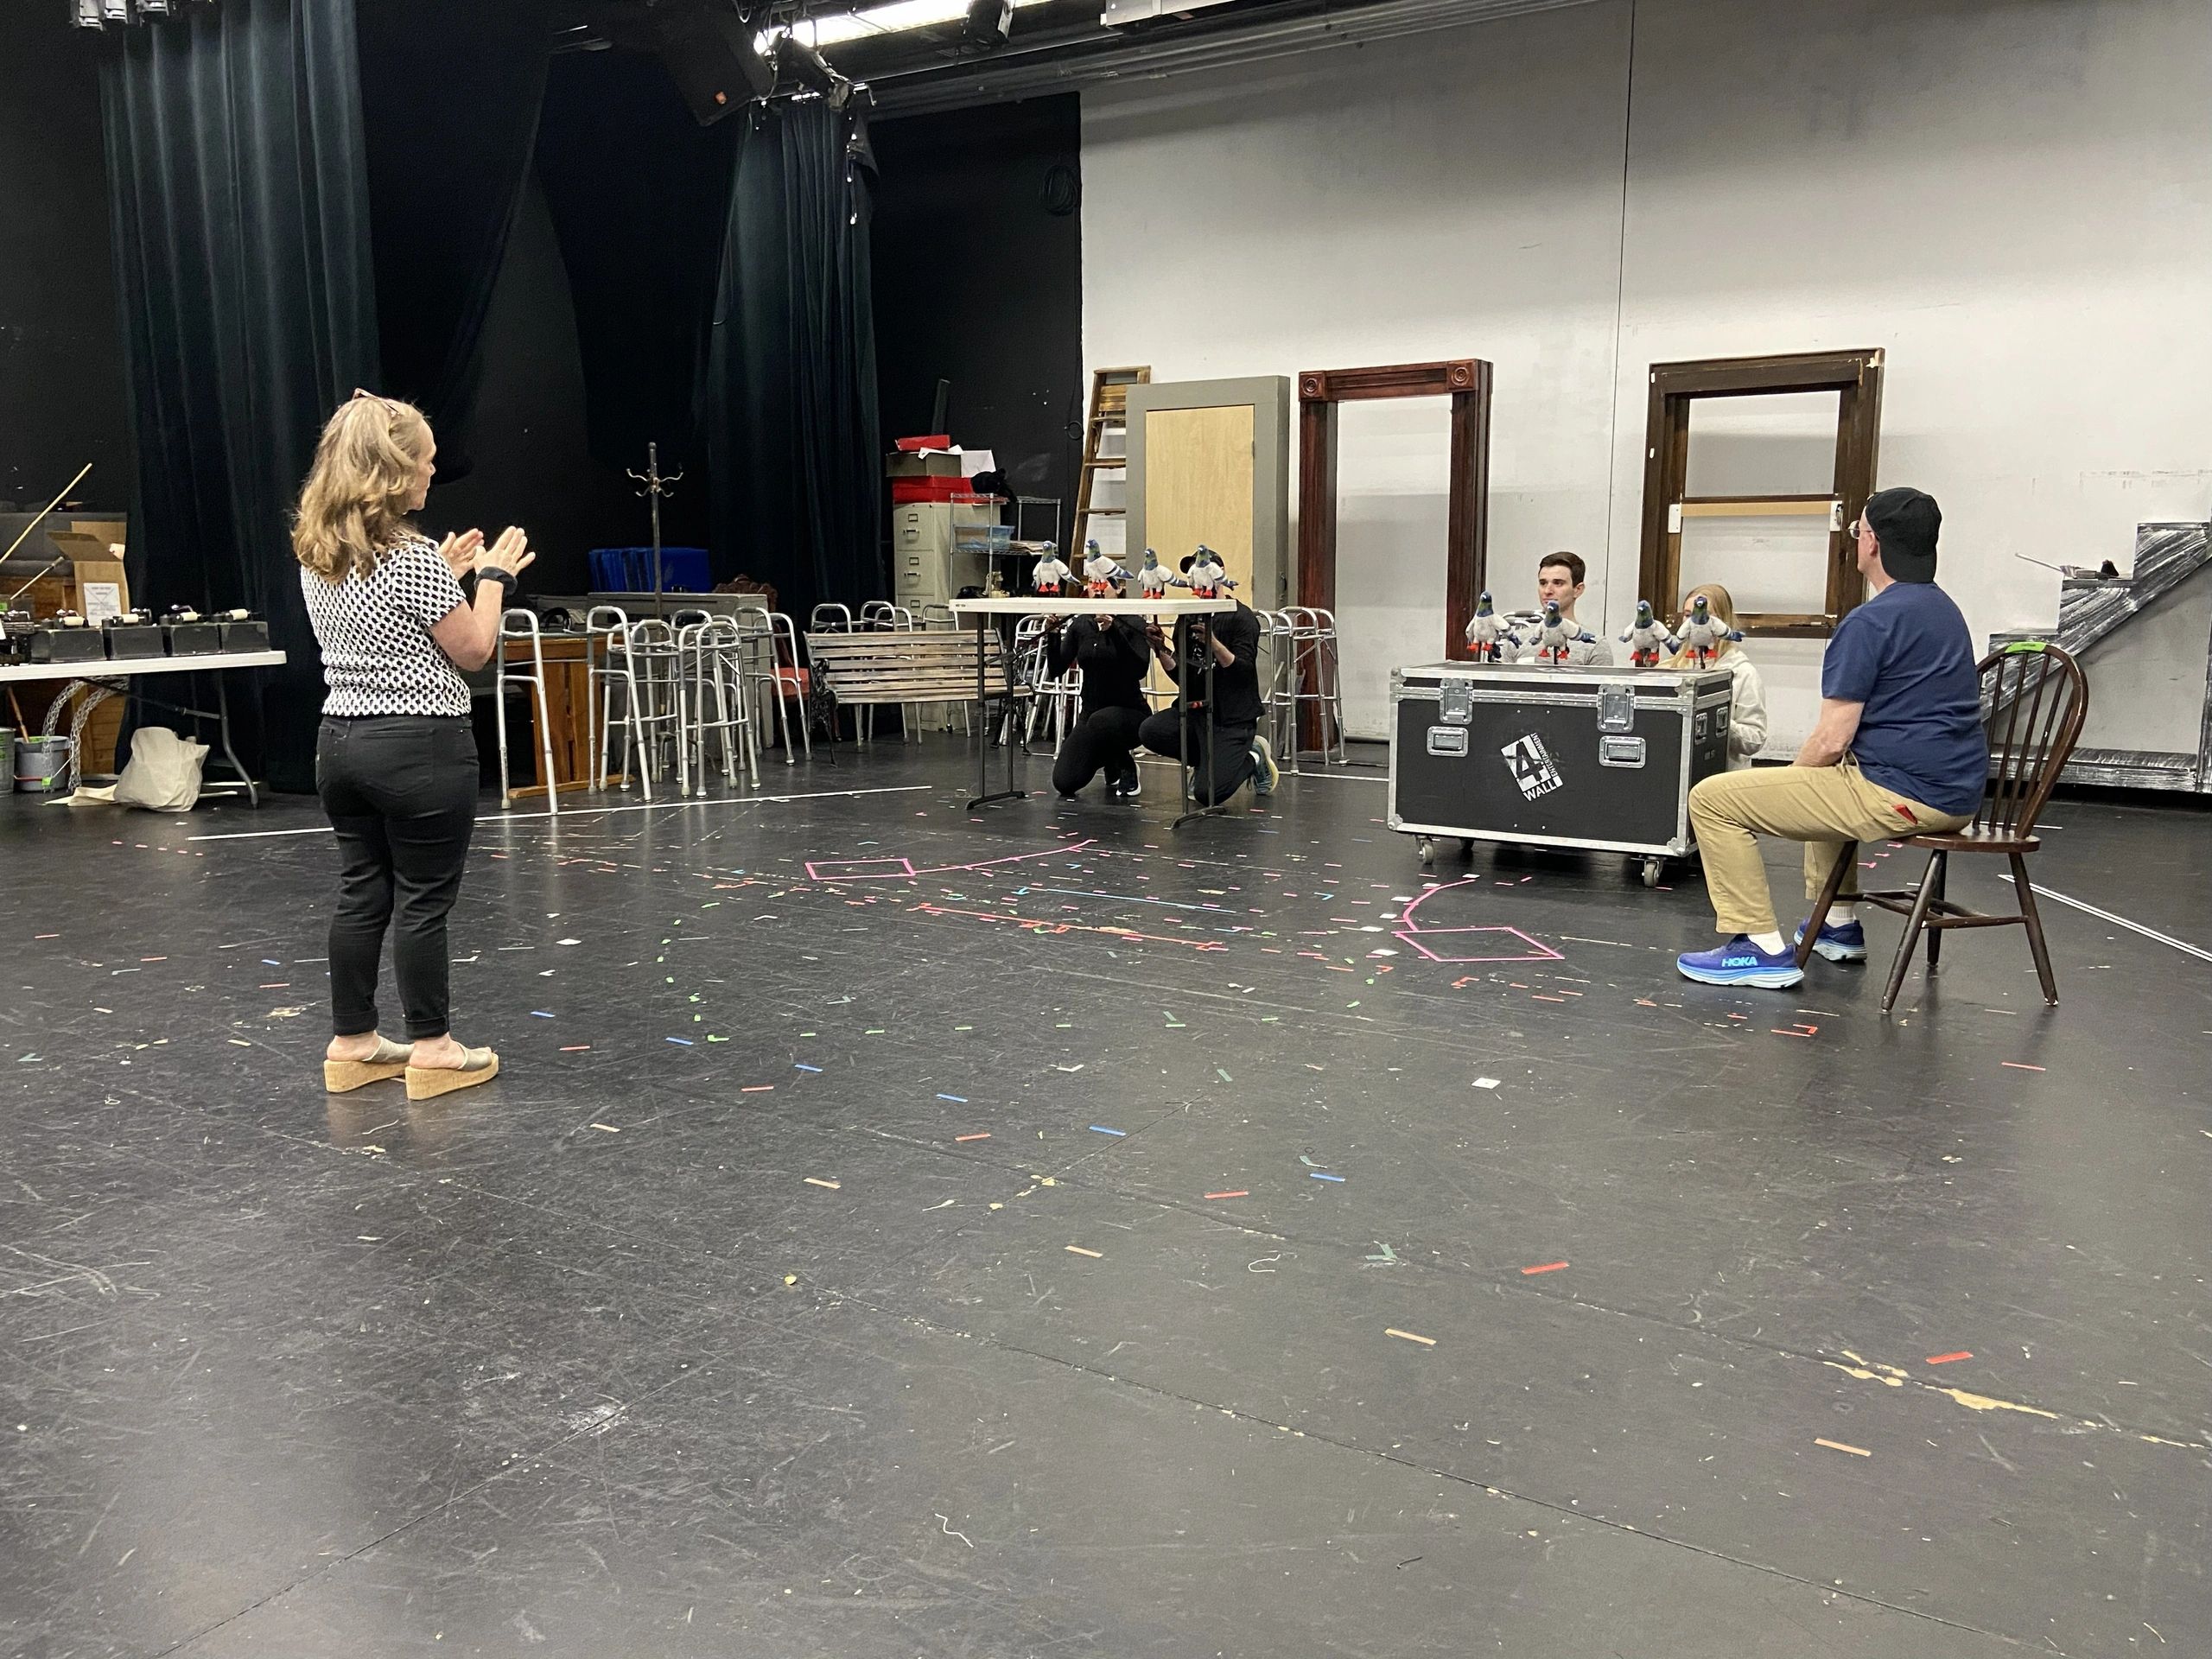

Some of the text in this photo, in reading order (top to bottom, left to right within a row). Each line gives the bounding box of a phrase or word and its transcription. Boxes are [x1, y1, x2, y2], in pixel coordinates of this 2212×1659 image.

[1530, 733, 1559, 777] ENTERTAINMENT
[1522, 780, 1557, 802] WALL
[1721, 956, 1758, 967] HOKA
